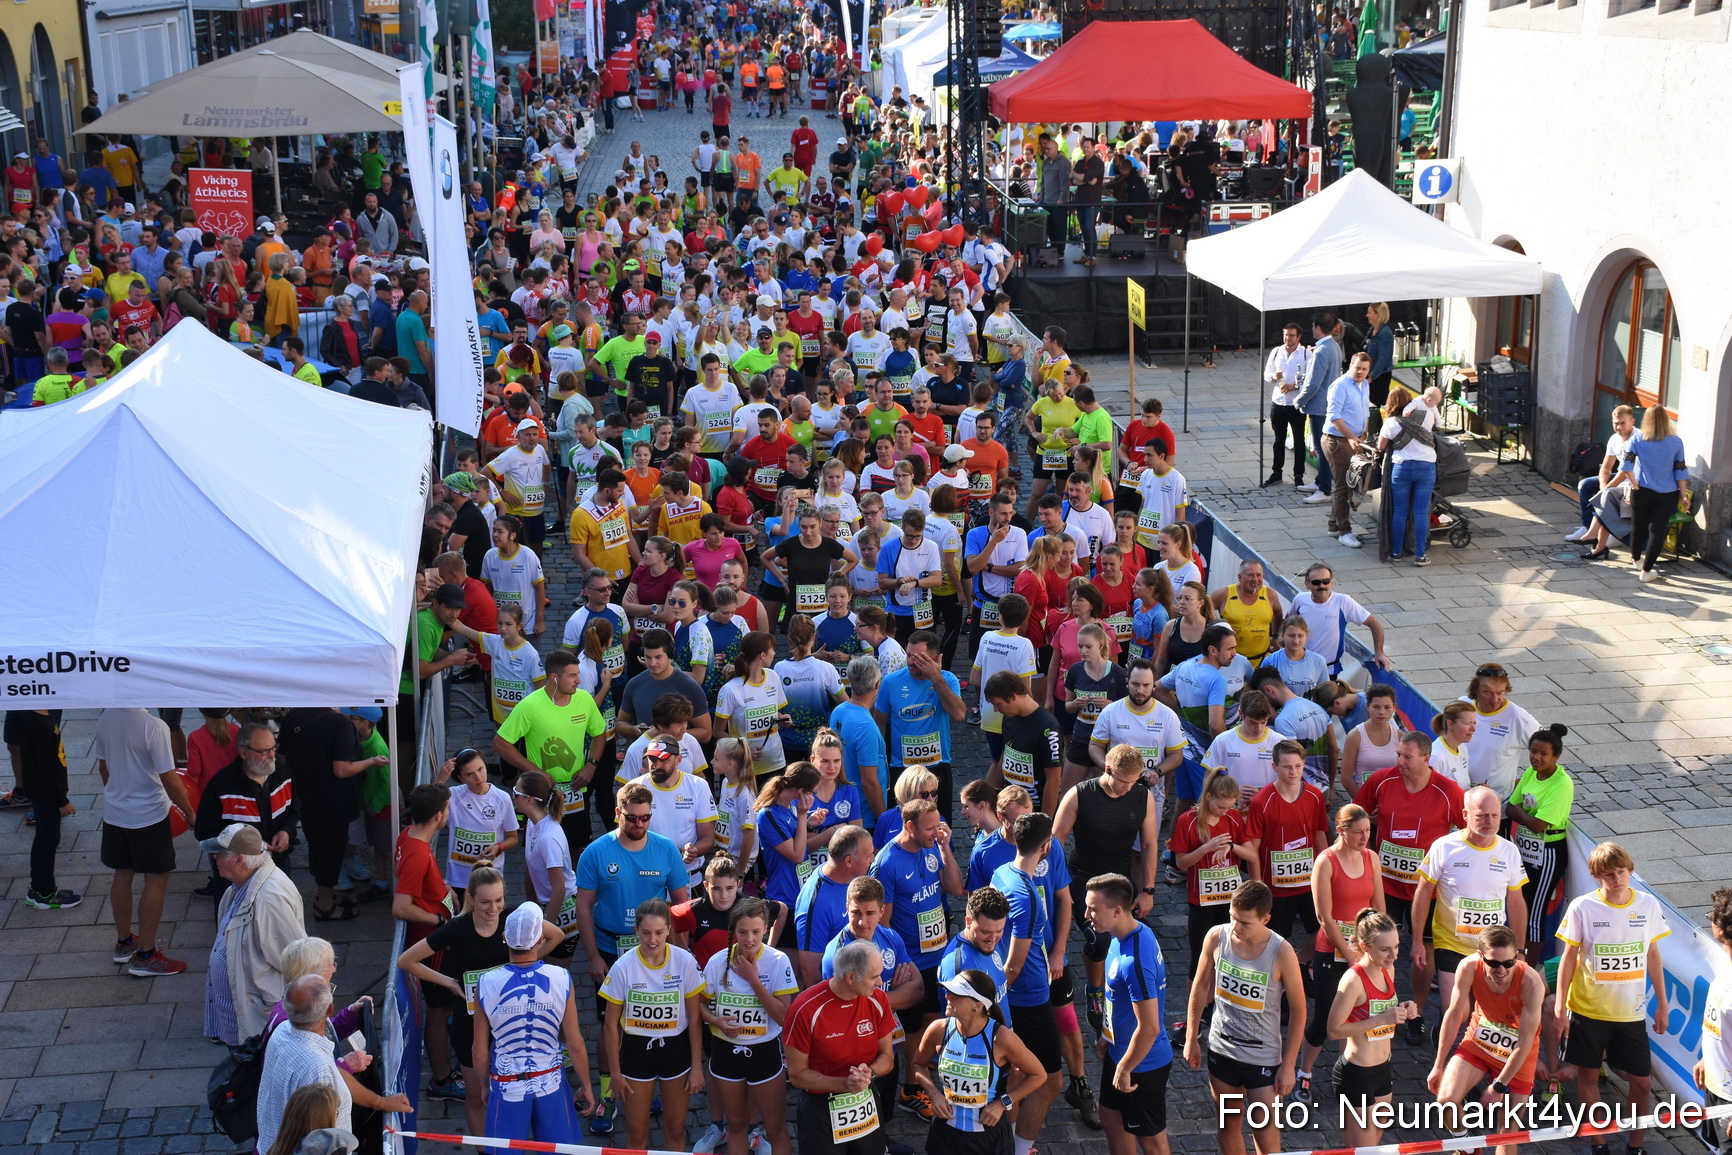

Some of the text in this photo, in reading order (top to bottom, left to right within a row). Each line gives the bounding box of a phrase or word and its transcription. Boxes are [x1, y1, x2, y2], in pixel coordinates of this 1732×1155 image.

[204, 106, 295, 115] Neumarkter
[182, 113, 309, 128] Lammsbräu
[202, 175, 238, 187] Viking
[195, 187, 248, 198] Athletics
[1131, 288, 1142, 305] FUN
[1131, 302, 1143, 320] RUN
[465, 316, 483, 386] NEUMARKT
[708, 419, 729, 427] 5246
[1045, 456, 1064, 464] 5045
[757, 475, 778, 484] 5179
[527, 493, 544, 502] 5243
[668, 518, 684, 526] MAX
[1140, 517, 1158, 529] 5278
[605, 528, 626, 540] 5101
[495, 591, 520, 599] BOCK
[797, 585, 825, 593] BOCK
[799, 593, 826, 604] 5129
[988, 640, 1018, 651] Neumarkter
[603, 656, 624, 668] 5212
[7, 680, 57, 696] sein.
[496, 679, 525, 690] BOCK
[496, 689, 522, 700] 5286
[746, 704, 777, 719] BOCK
[903, 732, 939, 746] BOCK
[906, 745, 937, 757] 5094
[1005, 746, 1030, 761] BOCK
[1005, 759, 1030, 775] 5203
[1004, 772, 1029, 783] ANDREAS
[457, 830, 493, 842] BOCK
[1274, 850, 1311, 861] BOCK
[1382, 844, 1422, 859] BOCK
[1276, 863, 1310, 876] 5184
[1382, 855, 1418, 872] 5185
[1202, 868, 1236, 879] BOCK
[1276, 875, 1311, 884] SEBASTIAN
[1385, 869, 1414, 880] HELMUT
[1205, 880, 1238, 893] 5183
[1463, 900, 1500, 910] BOCK
[1463, 912, 1498, 925] 5269
[1599, 944, 1640, 955] BOCK
[1600, 956, 1639, 971] 5251
[1223, 962, 1263, 983] BOCK
[1221, 975, 1260, 999] 5266
[629, 992, 675, 1004] BOCK
[722, 996, 761, 1007] BOCK
[496, 999, 557, 1014] Team Hähnel
[632, 1005, 673, 1020] 5003
[634, 1021, 669, 1029] LUCIANA
[942, 1062, 983, 1077] BOCK
[943, 1076, 981, 1093] 5141
[834, 1089, 871, 1107] BOCK
[838, 1105, 874, 1126] 5230
[838, 1118, 875, 1137] BERRNHARD
